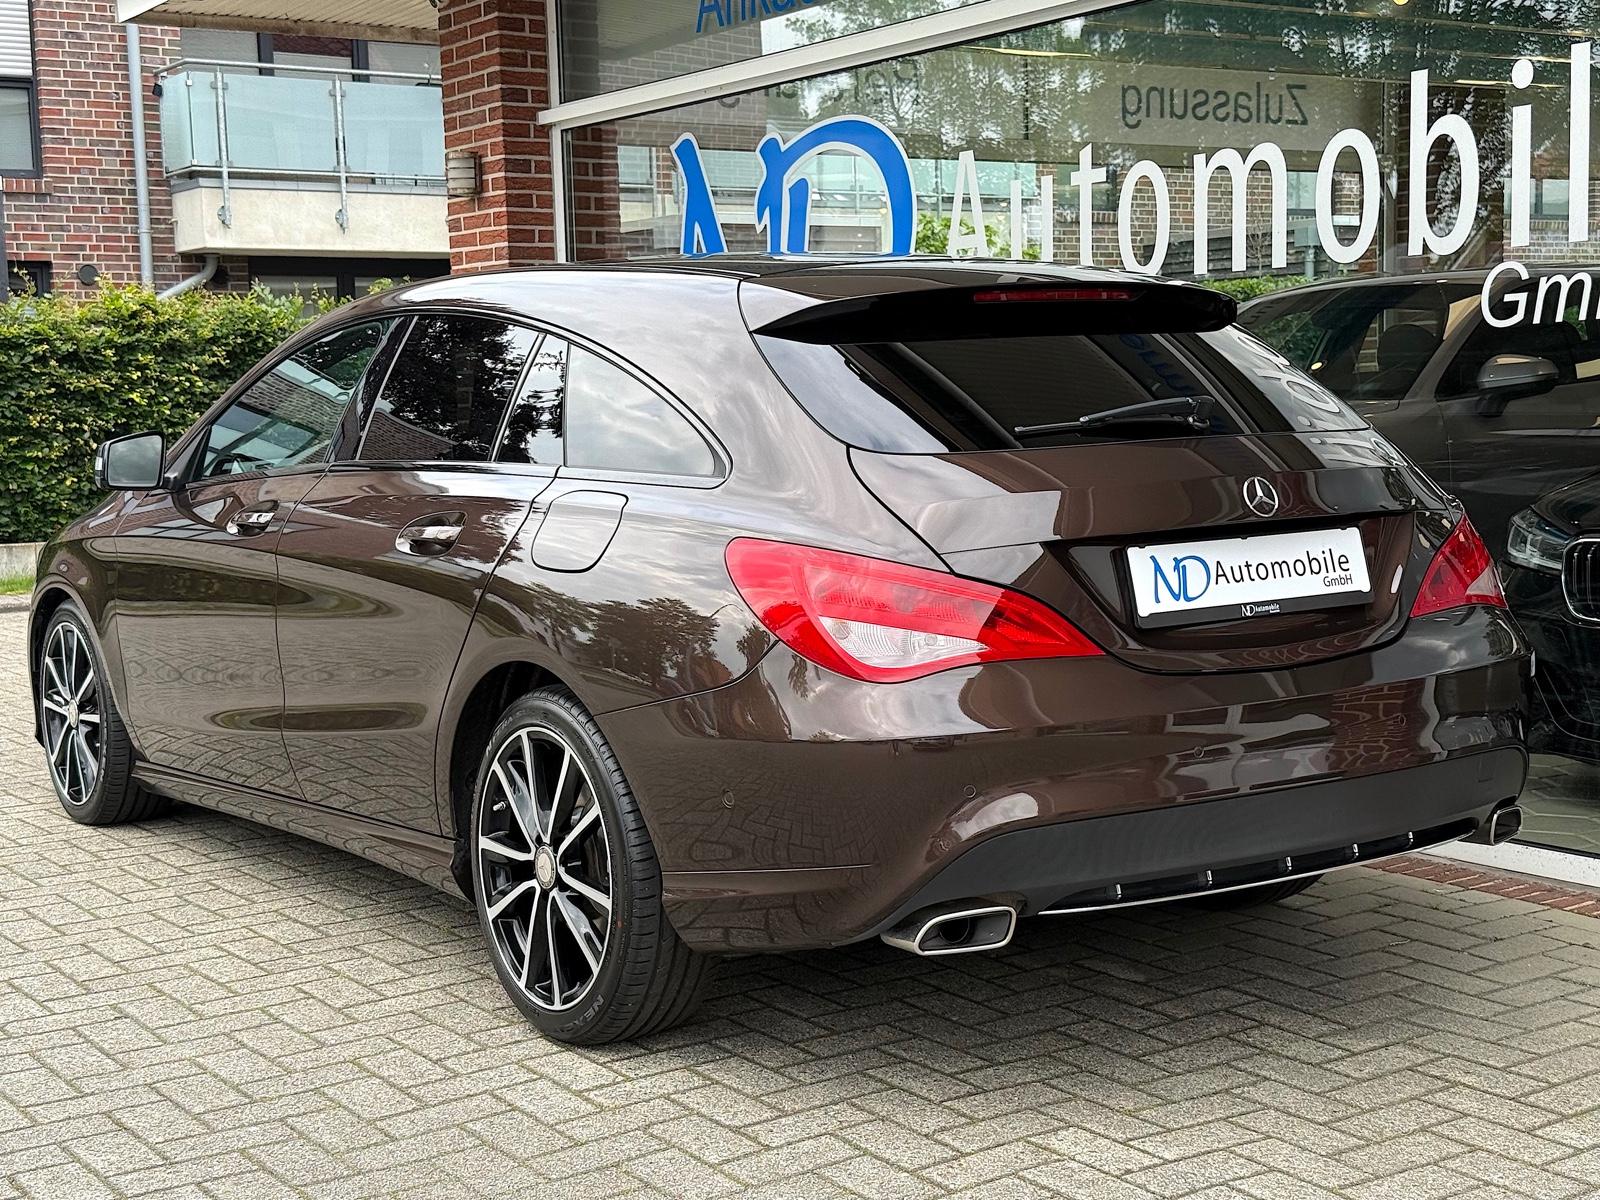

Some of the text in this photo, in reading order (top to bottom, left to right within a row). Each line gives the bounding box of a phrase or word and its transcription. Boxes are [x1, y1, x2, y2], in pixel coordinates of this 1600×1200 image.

[1480, 260, 1600, 328] Gm
[1150, 548, 1350, 604] ND Automobile
[1323, 574, 1353, 588] GmbH
